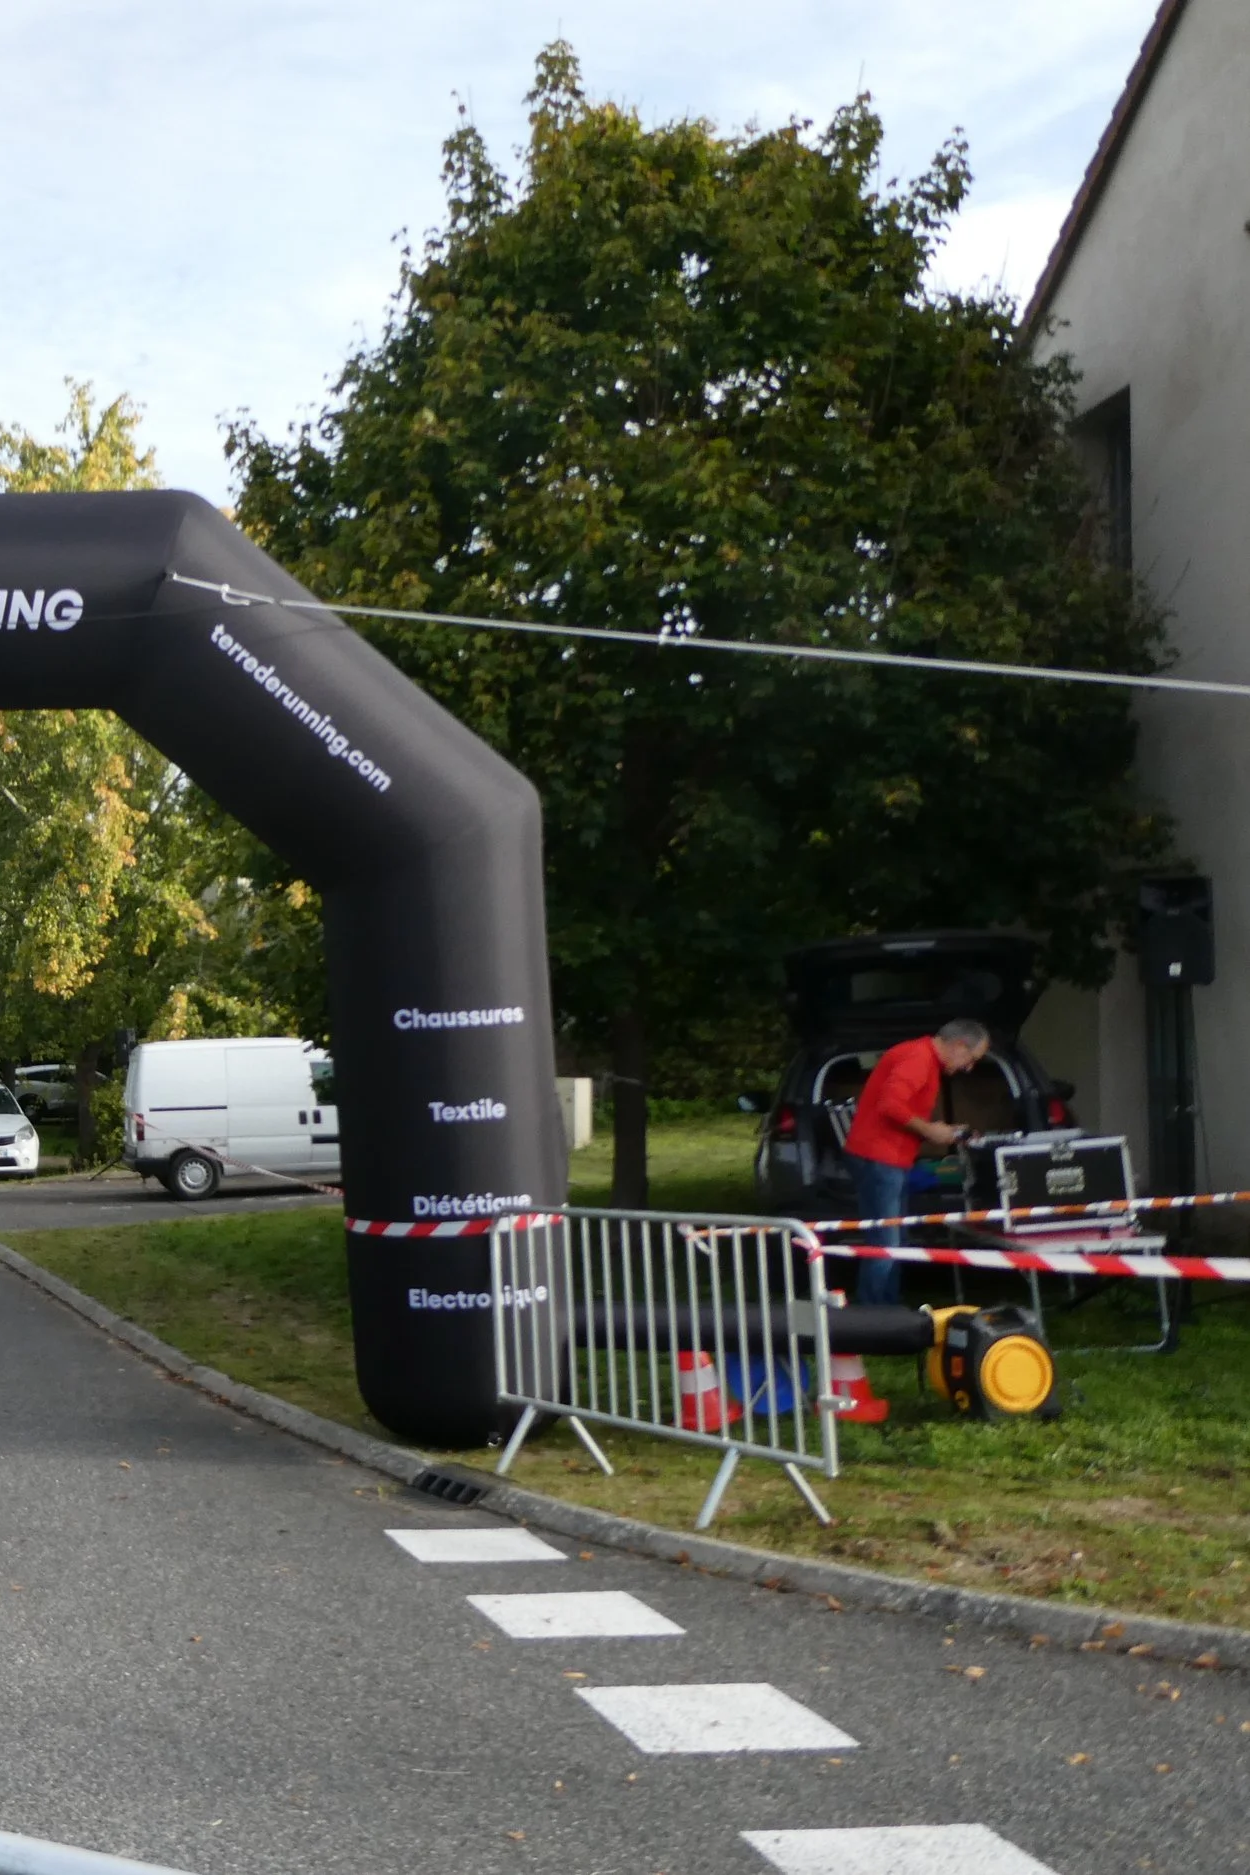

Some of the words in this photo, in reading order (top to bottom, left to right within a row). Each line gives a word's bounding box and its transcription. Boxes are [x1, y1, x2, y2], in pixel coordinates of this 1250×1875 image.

[210, 622, 392, 793] terrederunning.com
[393, 1004, 525, 1031] Chaussures
[428, 1098, 507, 1123] Textile
[408, 1285, 548, 1309] Electroique
